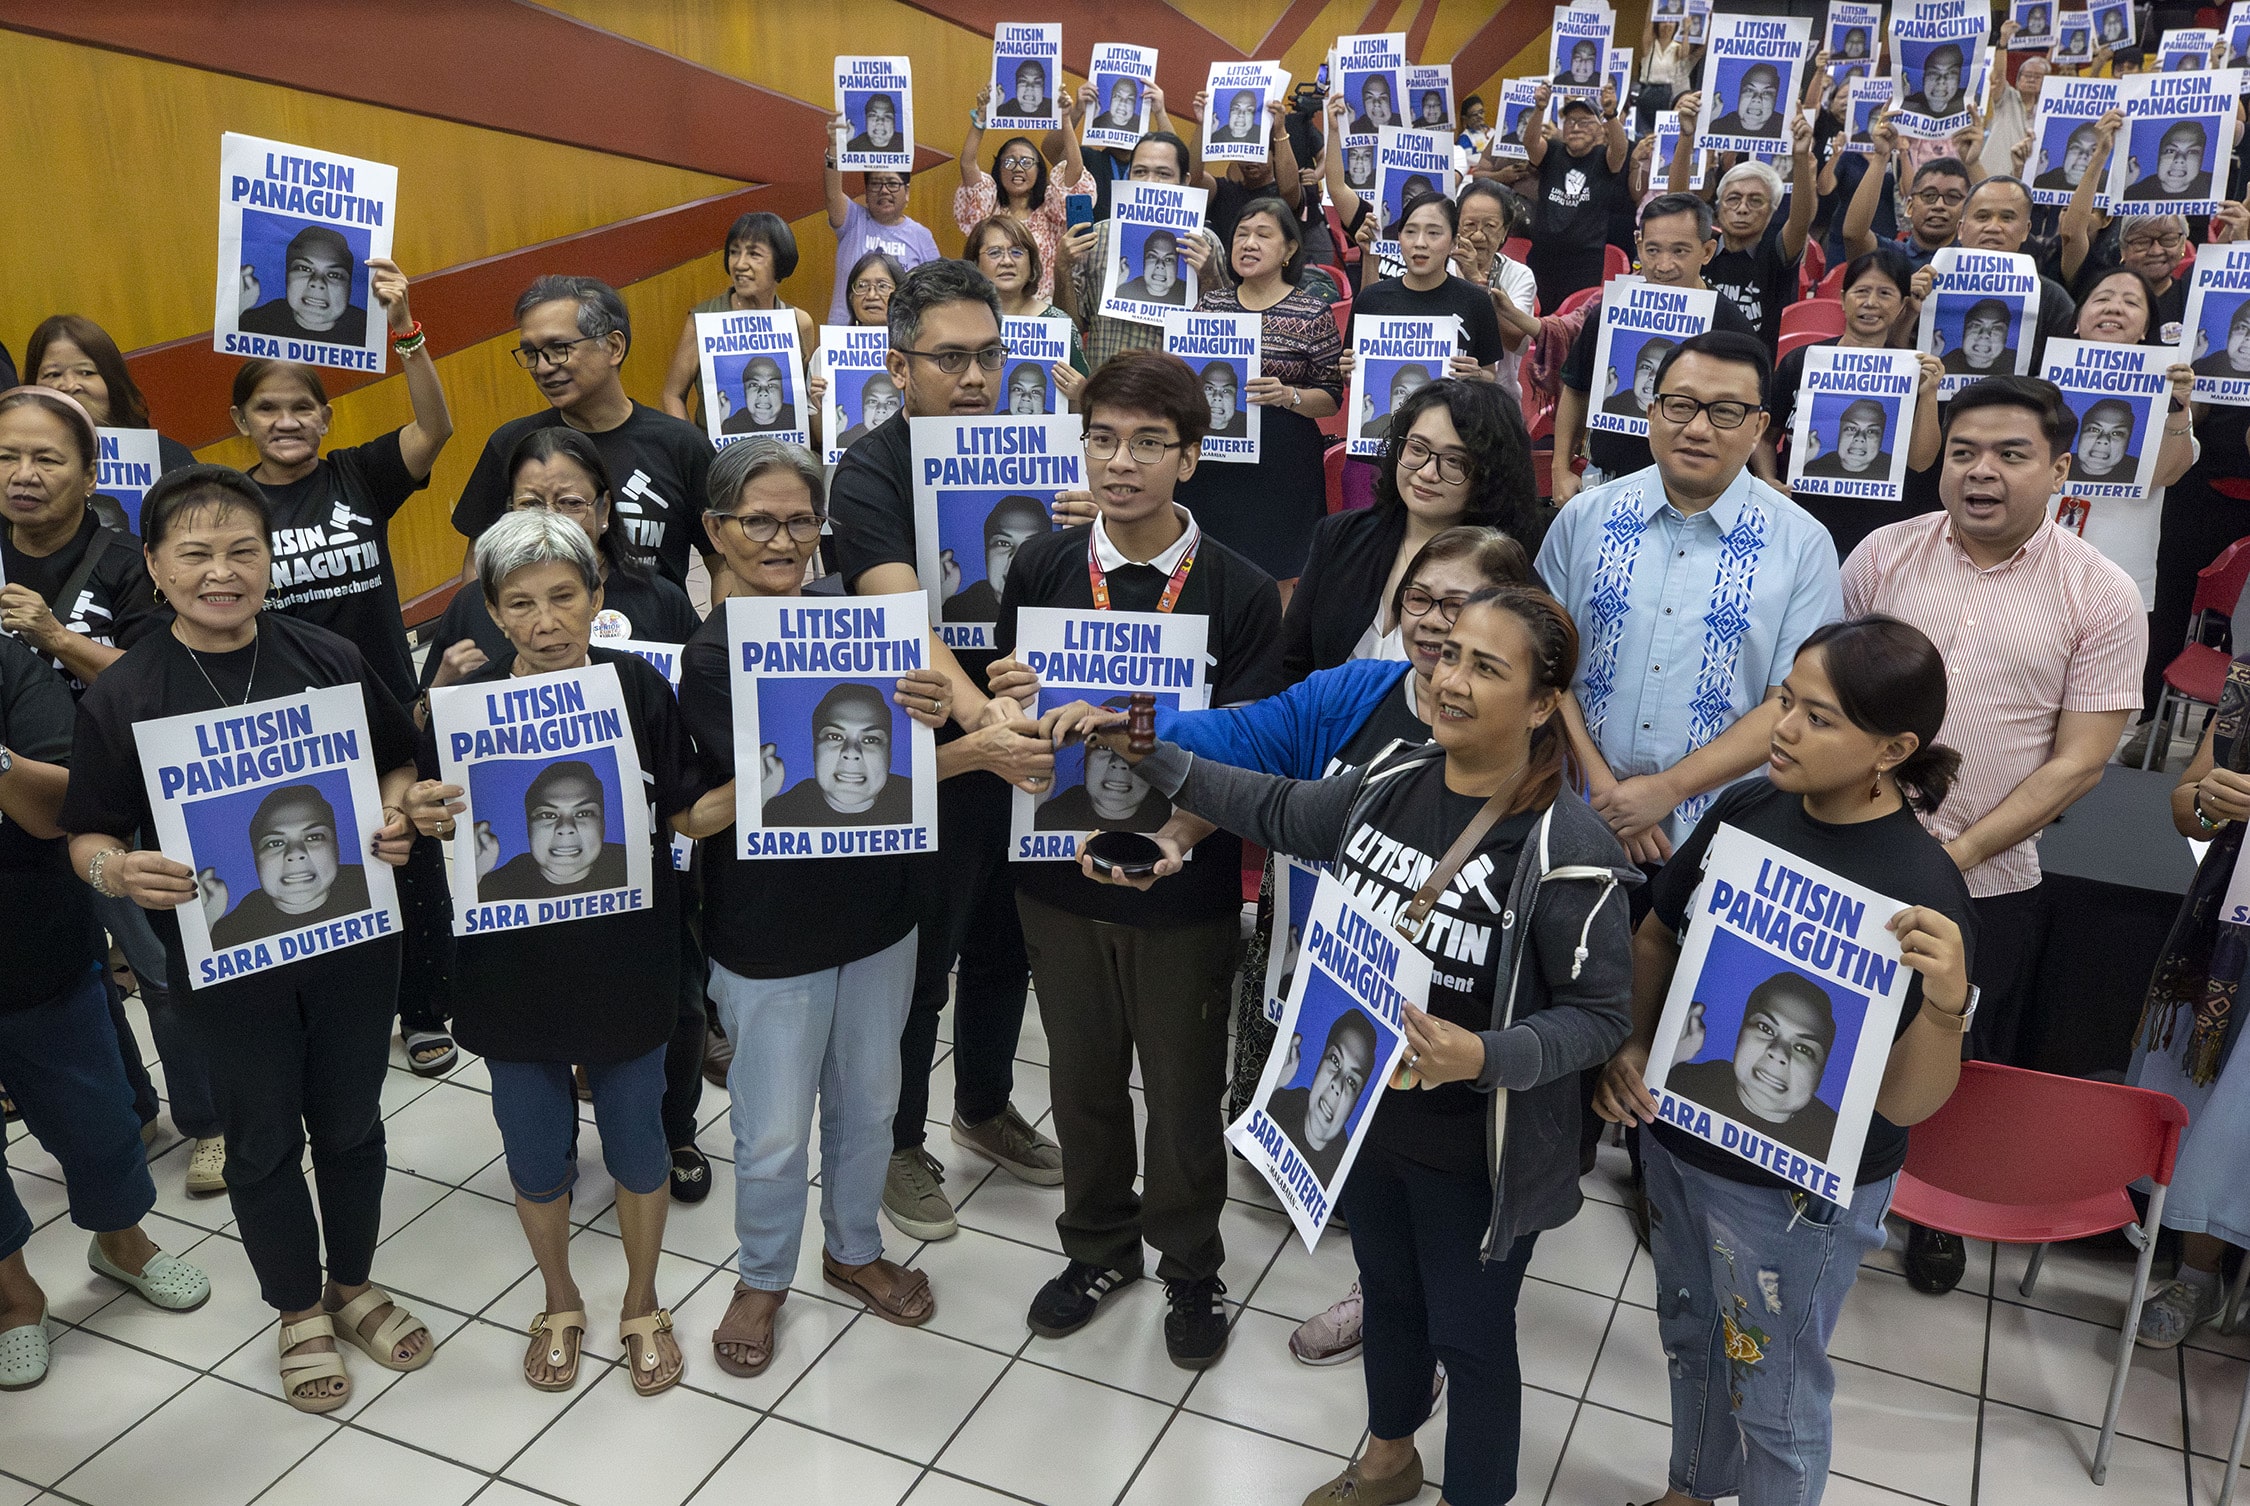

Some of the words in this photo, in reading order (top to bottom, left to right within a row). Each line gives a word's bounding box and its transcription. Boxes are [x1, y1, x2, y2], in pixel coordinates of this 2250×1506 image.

[1568, 12, 1599, 24] LITISIN
[1916, 0, 1965, 20] LITISIN
[1006, 28, 1044, 41] LITISIN
[1556, 22, 1610, 36] PANAGUTIN
[1735, 21, 1786, 40] LITISIN
[1894, 16, 1984, 38] PANAGUTIN
[2176, 32, 2206, 40] LITISIN
[995, 42, 1058, 55] PANAGUTIN
[1106, 48, 1142, 62] LITISIN
[1354, 40, 1388, 54] LITISIN
[1714, 38, 1802, 58] PANAGUTIN
[852, 61, 892, 74] LITISIN
[1094, 60, 1152, 76] PANAGUTIN
[1227, 66, 1262, 76] LITISIN
[1340, 54, 1400, 70] PANAGUTIN
[839, 74, 907, 89] PANAGUTIN
[1212, 76, 1272, 86] PANAGUTIN
[2150, 77, 2212, 97] LITISIN
[2064, 83, 2118, 100] LITISIN
[2126, 94, 2232, 116] PANAGUTIN
[990, 118, 1015, 128] SARA
[1018, 118, 1058, 130] DUTERTE
[1922, 113, 1972, 132] DUTERTE
[1086, 130, 1106, 139] SARA
[1346, 136, 1366, 146] SARA
[1396, 132, 1434, 152] LITISIN
[1700, 136, 1730, 150] SARA
[1735, 138, 1788, 153] DUTERTE
[841, 154, 866, 164] SARA
[870, 154, 910, 164] DUTERTE
[1205, 144, 1225, 154] SARA
[1228, 144, 1265, 156] DUTERTE
[1382, 148, 1450, 170] PANAGUTIN
[266, 152, 354, 194] LITISIN
[232, 176, 384, 226] PANAGUTIN
[1134, 187, 1184, 208] LITISIN
[1116, 202, 1199, 228] PANAGUTIN
[2114, 201, 2149, 215] SARA
[2155, 200, 2218, 216] DUTERTE
[1955, 254, 2014, 274] LITISIN
[1932, 273, 2034, 292] PANAGUTIN
[1105, 299, 1136, 313] SARA
[1630, 289, 1688, 314] LITISIN
[722, 316, 773, 335] LITISIN
[1001, 321, 1048, 340] ITISIN
[1186, 318, 1237, 337] LITISIN
[1607, 306, 1706, 335] PANAGUTIN
[846, 332, 888, 350] LITISI
[1380, 322, 1434, 340] LITISIN
[225, 334, 281, 358] SARA
[288, 342, 377, 370] DUTERTE
[704, 332, 794, 353] PANAGUTIN
[1169, 336, 1255, 356] PANAGUTIN
[1359, 338, 1452, 358] PANAGUTIN
[1832, 353, 1894, 374] LITISIN
[2075, 347, 2145, 372] LITISIN
[1808, 372, 1912, 394] PANAGUTIN
[2048, 366, 2166, 394] PANAGUTIN
[1592, 414, 1625, 432] SARA
[956, 426, 1046, 454] LITISIN
[1202, 438, 1254, 453] DUTERTE
[924, 456, 1080, 486] PANAGUTIN
[1792, 478, 1829, 494] SARA
[1834, 480, 1897, 498] DUTERTE
[2072, 483, 2142, 498] DUTERTE
[271, 540, 380, 589] NAGUTIN
[779, 607, 885, 640] LITISIN
[1064, 620, 1162, 654] LITISIN
[742, 638, 922, 672] PANAGUTIN
[1027, 652, 1194, 688] PANAGUTIN
[486, 680, 586, 726] LITISIN
[194, 704, 314, 758] LITISIN
[450, 708, 624, 762] PANAGUTIN
[158, 730, 360, 800] PANAGUTIN
[747, 832, 812, 856] SARA
[821, 827, 928, 854] DUTERTE
[1019, 835, 1076, 858] SARA
[1754, 858, 1866, 940] LITISIN
[465, 904, 530, 933] SARA
[538, 888, 642, 924] DUTERTE
[200, 942, 274, 984] SARA
[278, 910, 392, 962] DUTERTE
[1336, 902, 1400, 982] LITISIN
[1708, 879, 1898, 997] PANAGUTIN
[1246, 1110, 1284, 1162] SARA
[1280, 1148, 1328, 1228] DUTERTE
[1721, 1121, 1841, 1200] DUTERTE
